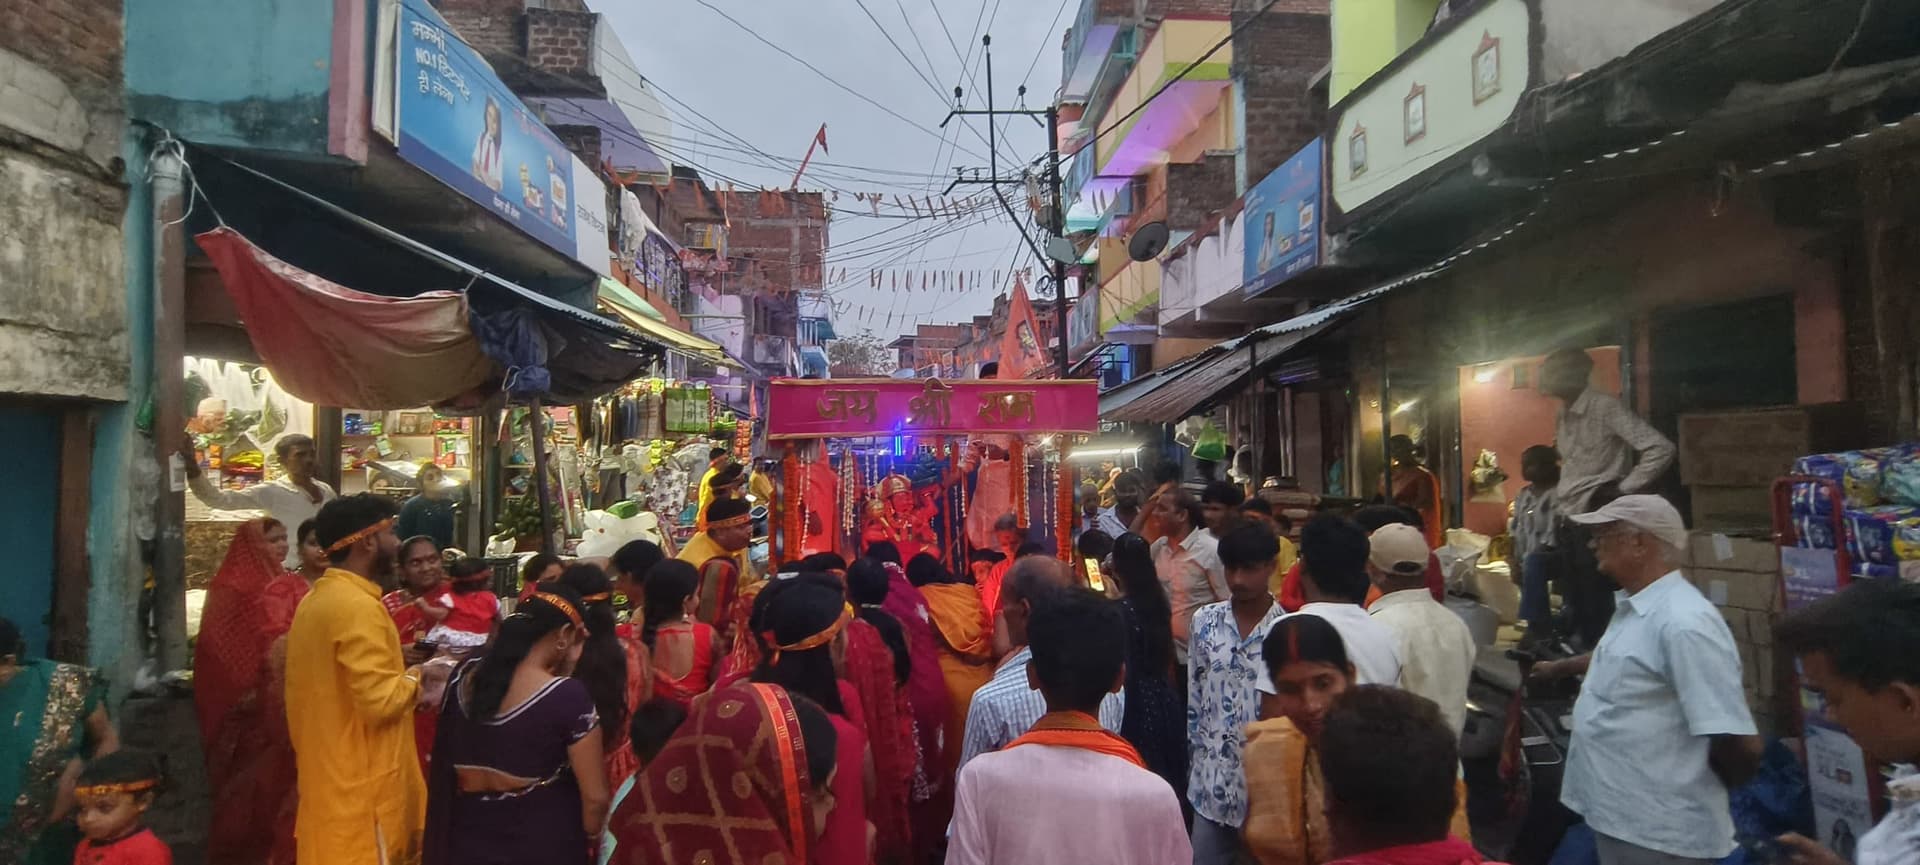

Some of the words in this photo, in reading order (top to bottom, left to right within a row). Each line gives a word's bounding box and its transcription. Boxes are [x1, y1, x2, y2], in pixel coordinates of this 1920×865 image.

[417, 69, 430, 93] ही
[432, 76, 455, 105] लेना
[816, 389, 880, 424] जय
[907, 376, 954, 427] श्री
[977, 390, 1037, 425] राम
